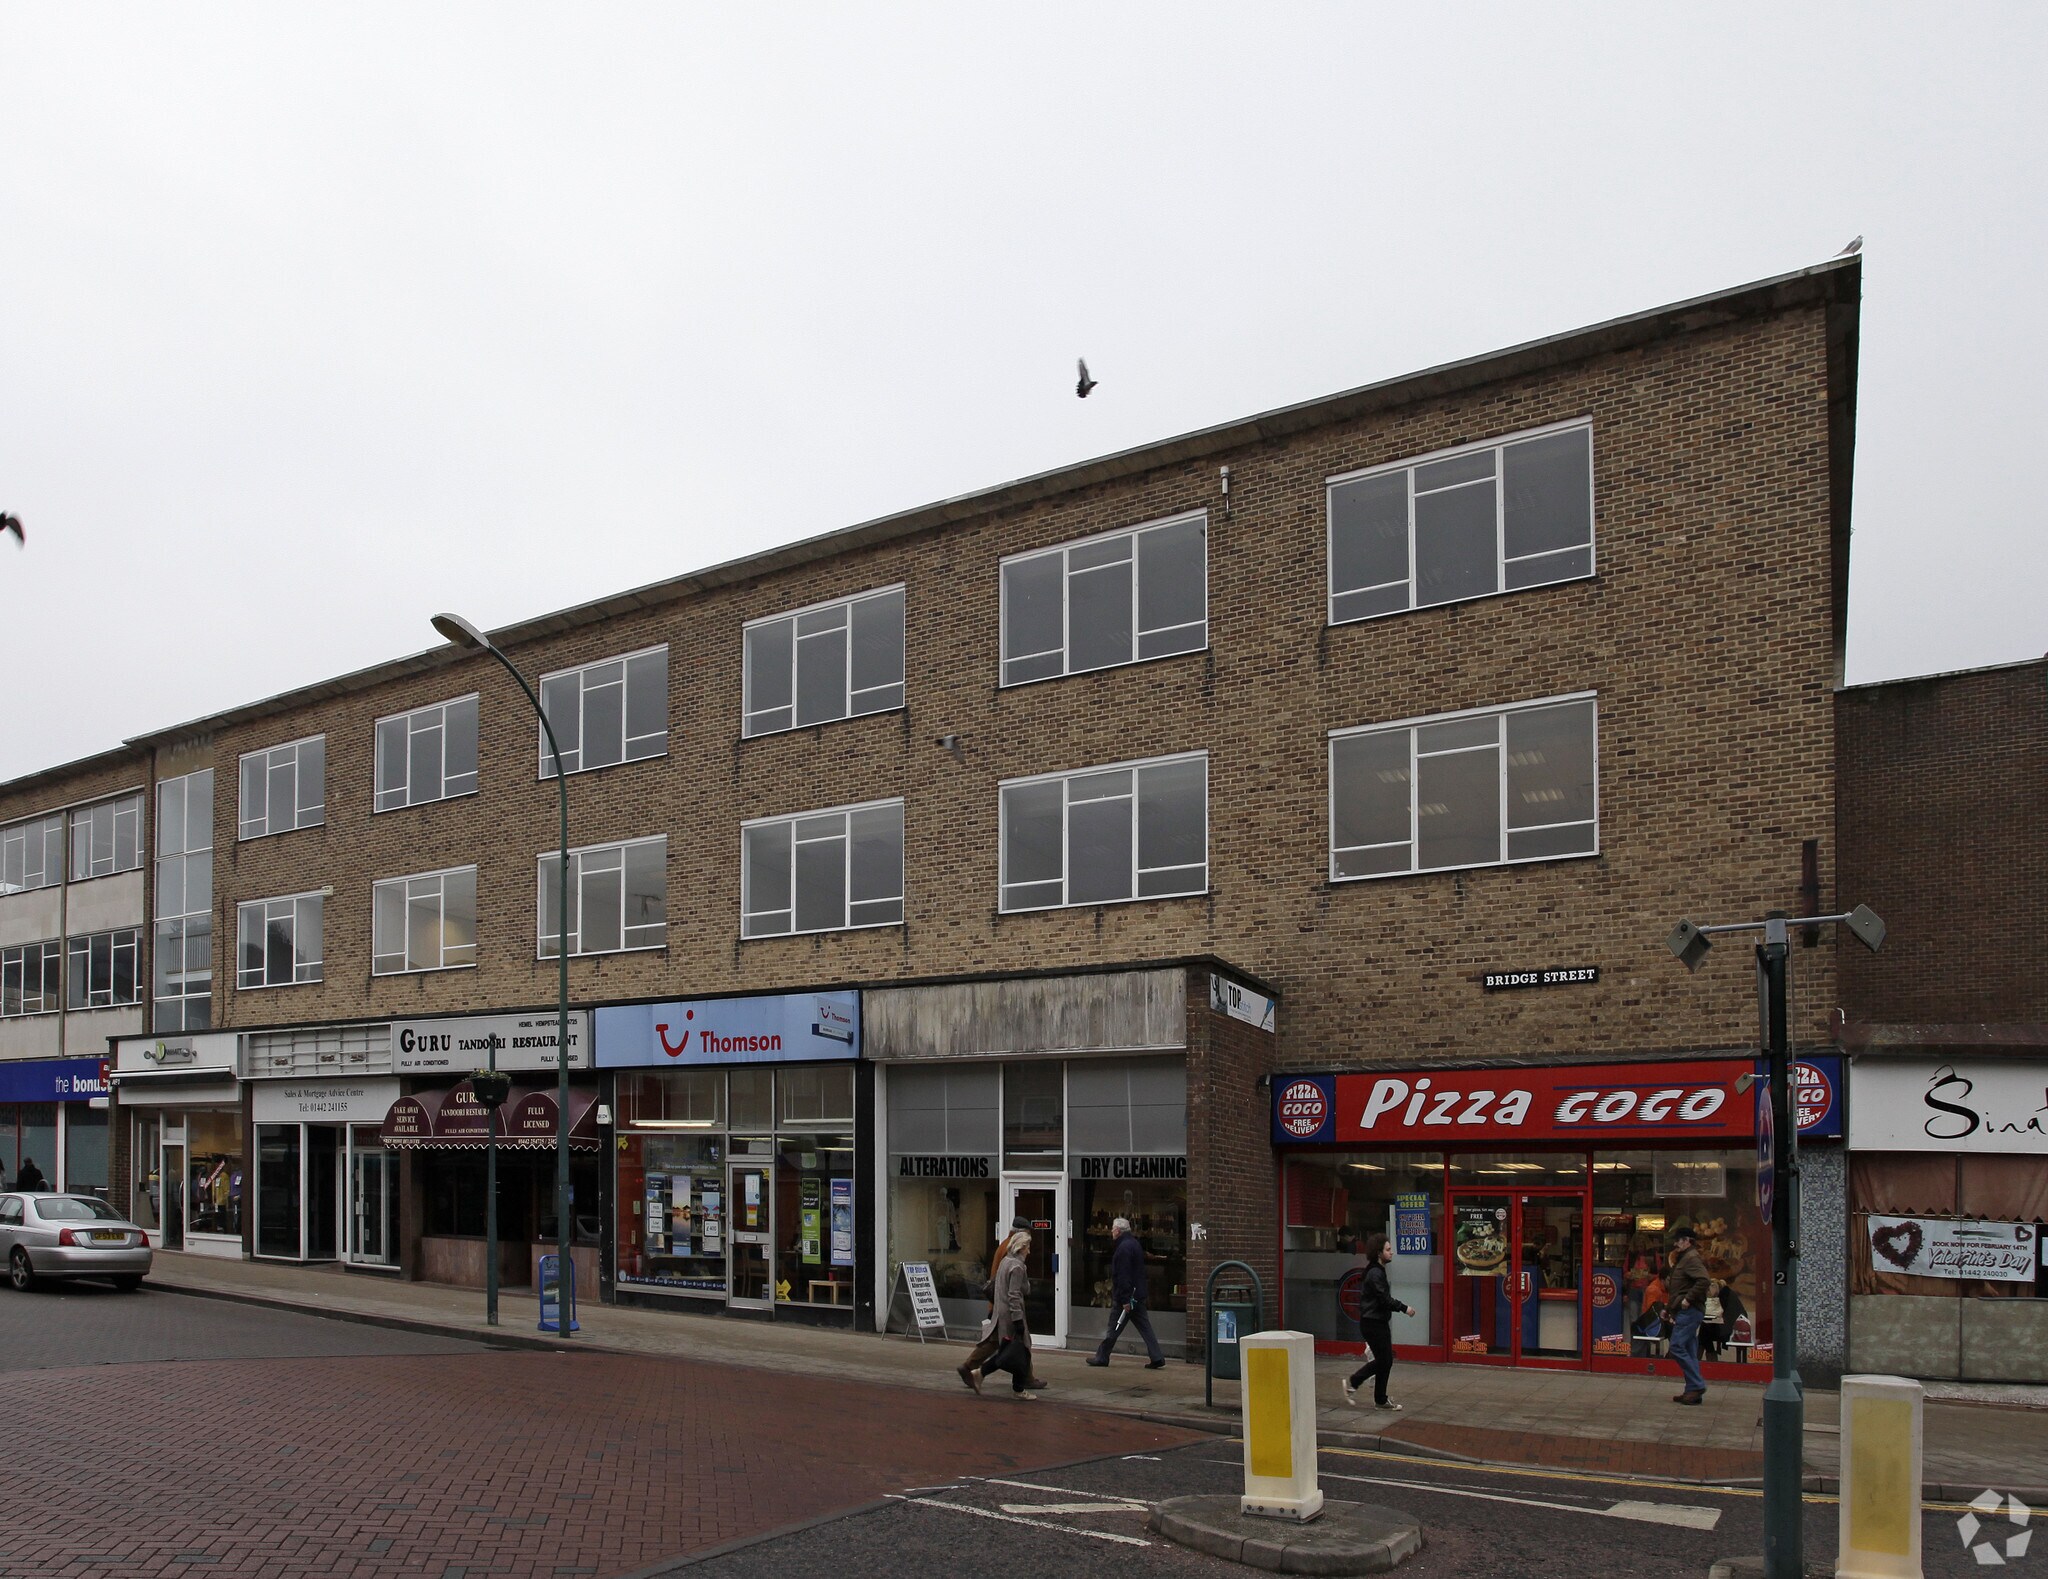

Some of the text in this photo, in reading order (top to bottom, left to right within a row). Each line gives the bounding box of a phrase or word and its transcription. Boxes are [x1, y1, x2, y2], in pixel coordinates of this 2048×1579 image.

[1486, 969, 1595, 986] BRIDGE STREET
[1228, 985, 1242, 1010] TOP
[832, 1012, 850, 1024] Thomson
[400, 1028, 451, 1052] GURU
[700, 1031, 781, 1053] Thomson
[55, 1076, 70, 1093] the
[1286, 1084, 1318, 1099] PIZZA
[284, 1088, 364, 1100] Sales & Mortgage Advice Centre
[456, 1092, 478, 1104] GUR
[299, 1102, 348, 1112] Tel: 01442 241155
[1282, 1102, 1322, 1115] GOGO
[1360, 1078, 1726, 1128] Pizza GOGO
[528, 1107, 545, 1115] FULLY
[1285, 1122, 1319, 1134] DELIVERY
[900, 1156, 988, 1178] ALTERATIONS
[1080, 1156, 1187, 1179] DRY CLEANING
[1400, 1236, 1426, 1250] £2.50
[1928, 1248, 2031, 1275] Valentine's Day
[1776, 1272, 1785, 1284] 2
